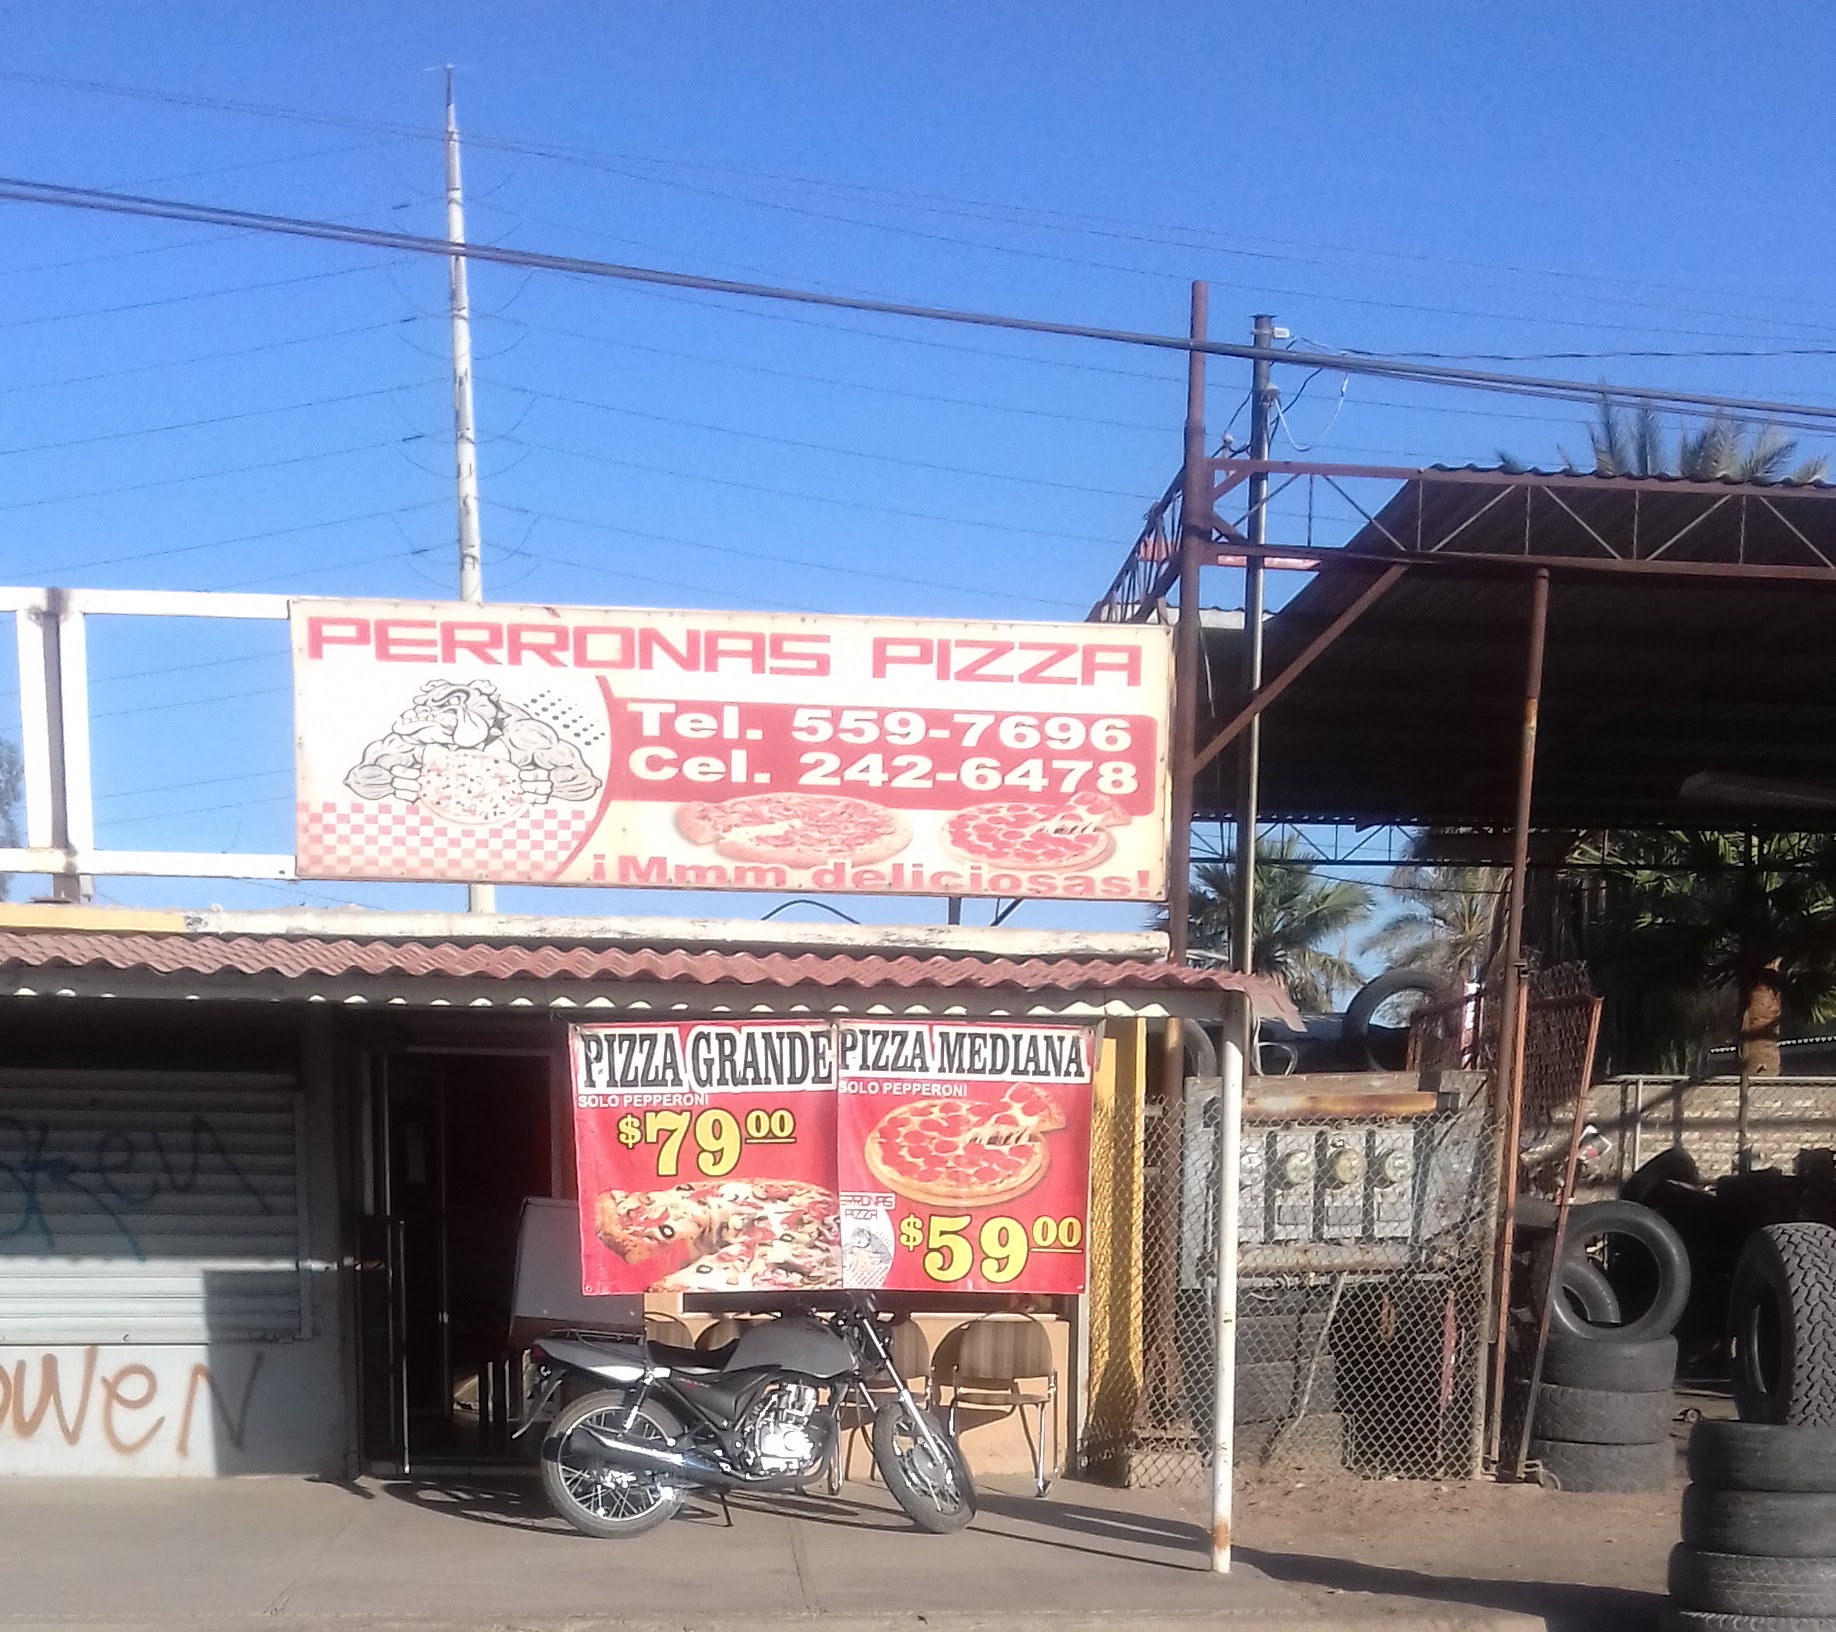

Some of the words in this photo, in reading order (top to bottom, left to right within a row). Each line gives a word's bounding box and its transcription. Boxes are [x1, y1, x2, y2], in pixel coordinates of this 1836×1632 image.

[308, 616, 831, 677] PERRONAS
[872, 636, 1142, 687] PIZZA
[626, 702, 764, 741] Tel.
[790, 707, 1133, 753] 559-7696
[627, 746, 771, 784] Cel.
[797, 751, 1140, 795] 242-6478
[810, 861, 1152, 899] deliciosas!
[580, 1032, 683, 1088] PIZZA
[691, 1030, 833, 1088] GRANDE
[839, 1028, 930, 1073] PIZZA
[938, 1031, 1086, 1079] MEDIANA
[577, 1093, 619, 1109] SOLO
[623, 1093, 709, 1108] PEPPERONI
[838, 1080, 880, 1096] SOLO
[882, 1081, 968, 1098] PEPPERONI
